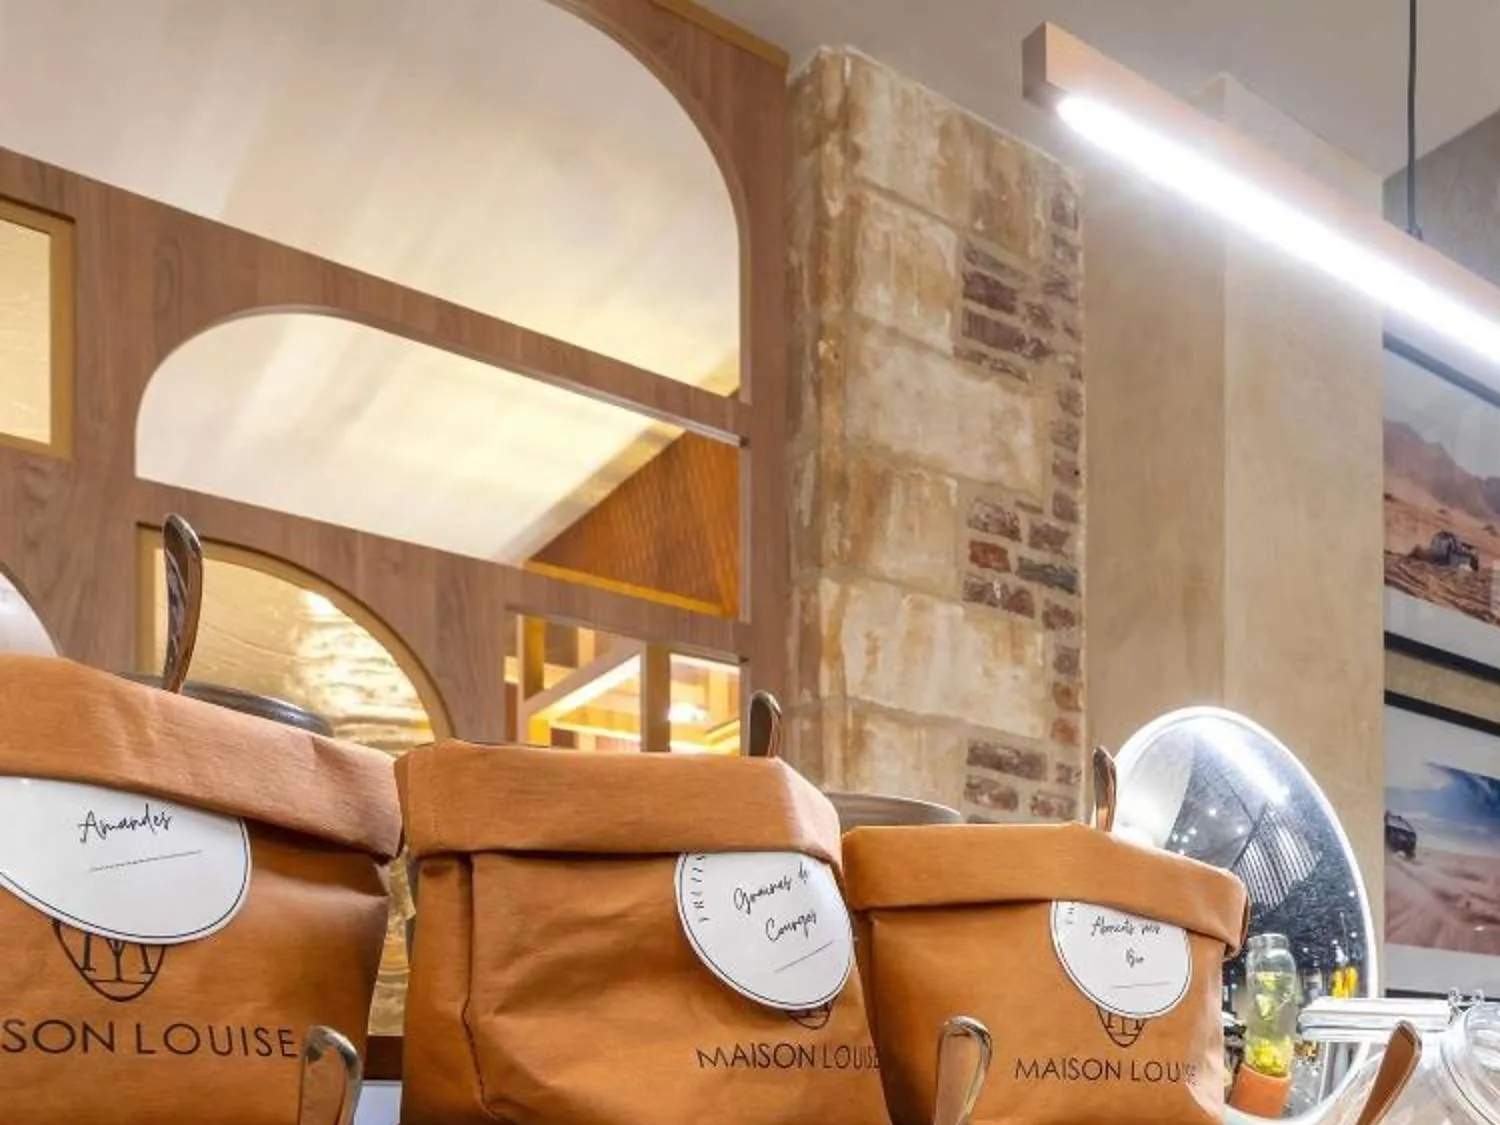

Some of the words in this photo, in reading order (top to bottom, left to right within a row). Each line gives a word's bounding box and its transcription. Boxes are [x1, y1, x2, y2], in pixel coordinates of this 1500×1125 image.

[135, 1023, 298, 1057] LOUISE
[696, 1042, 815, 1069] MAISON
[1015, 1058, 1121, 1081] MAISON
